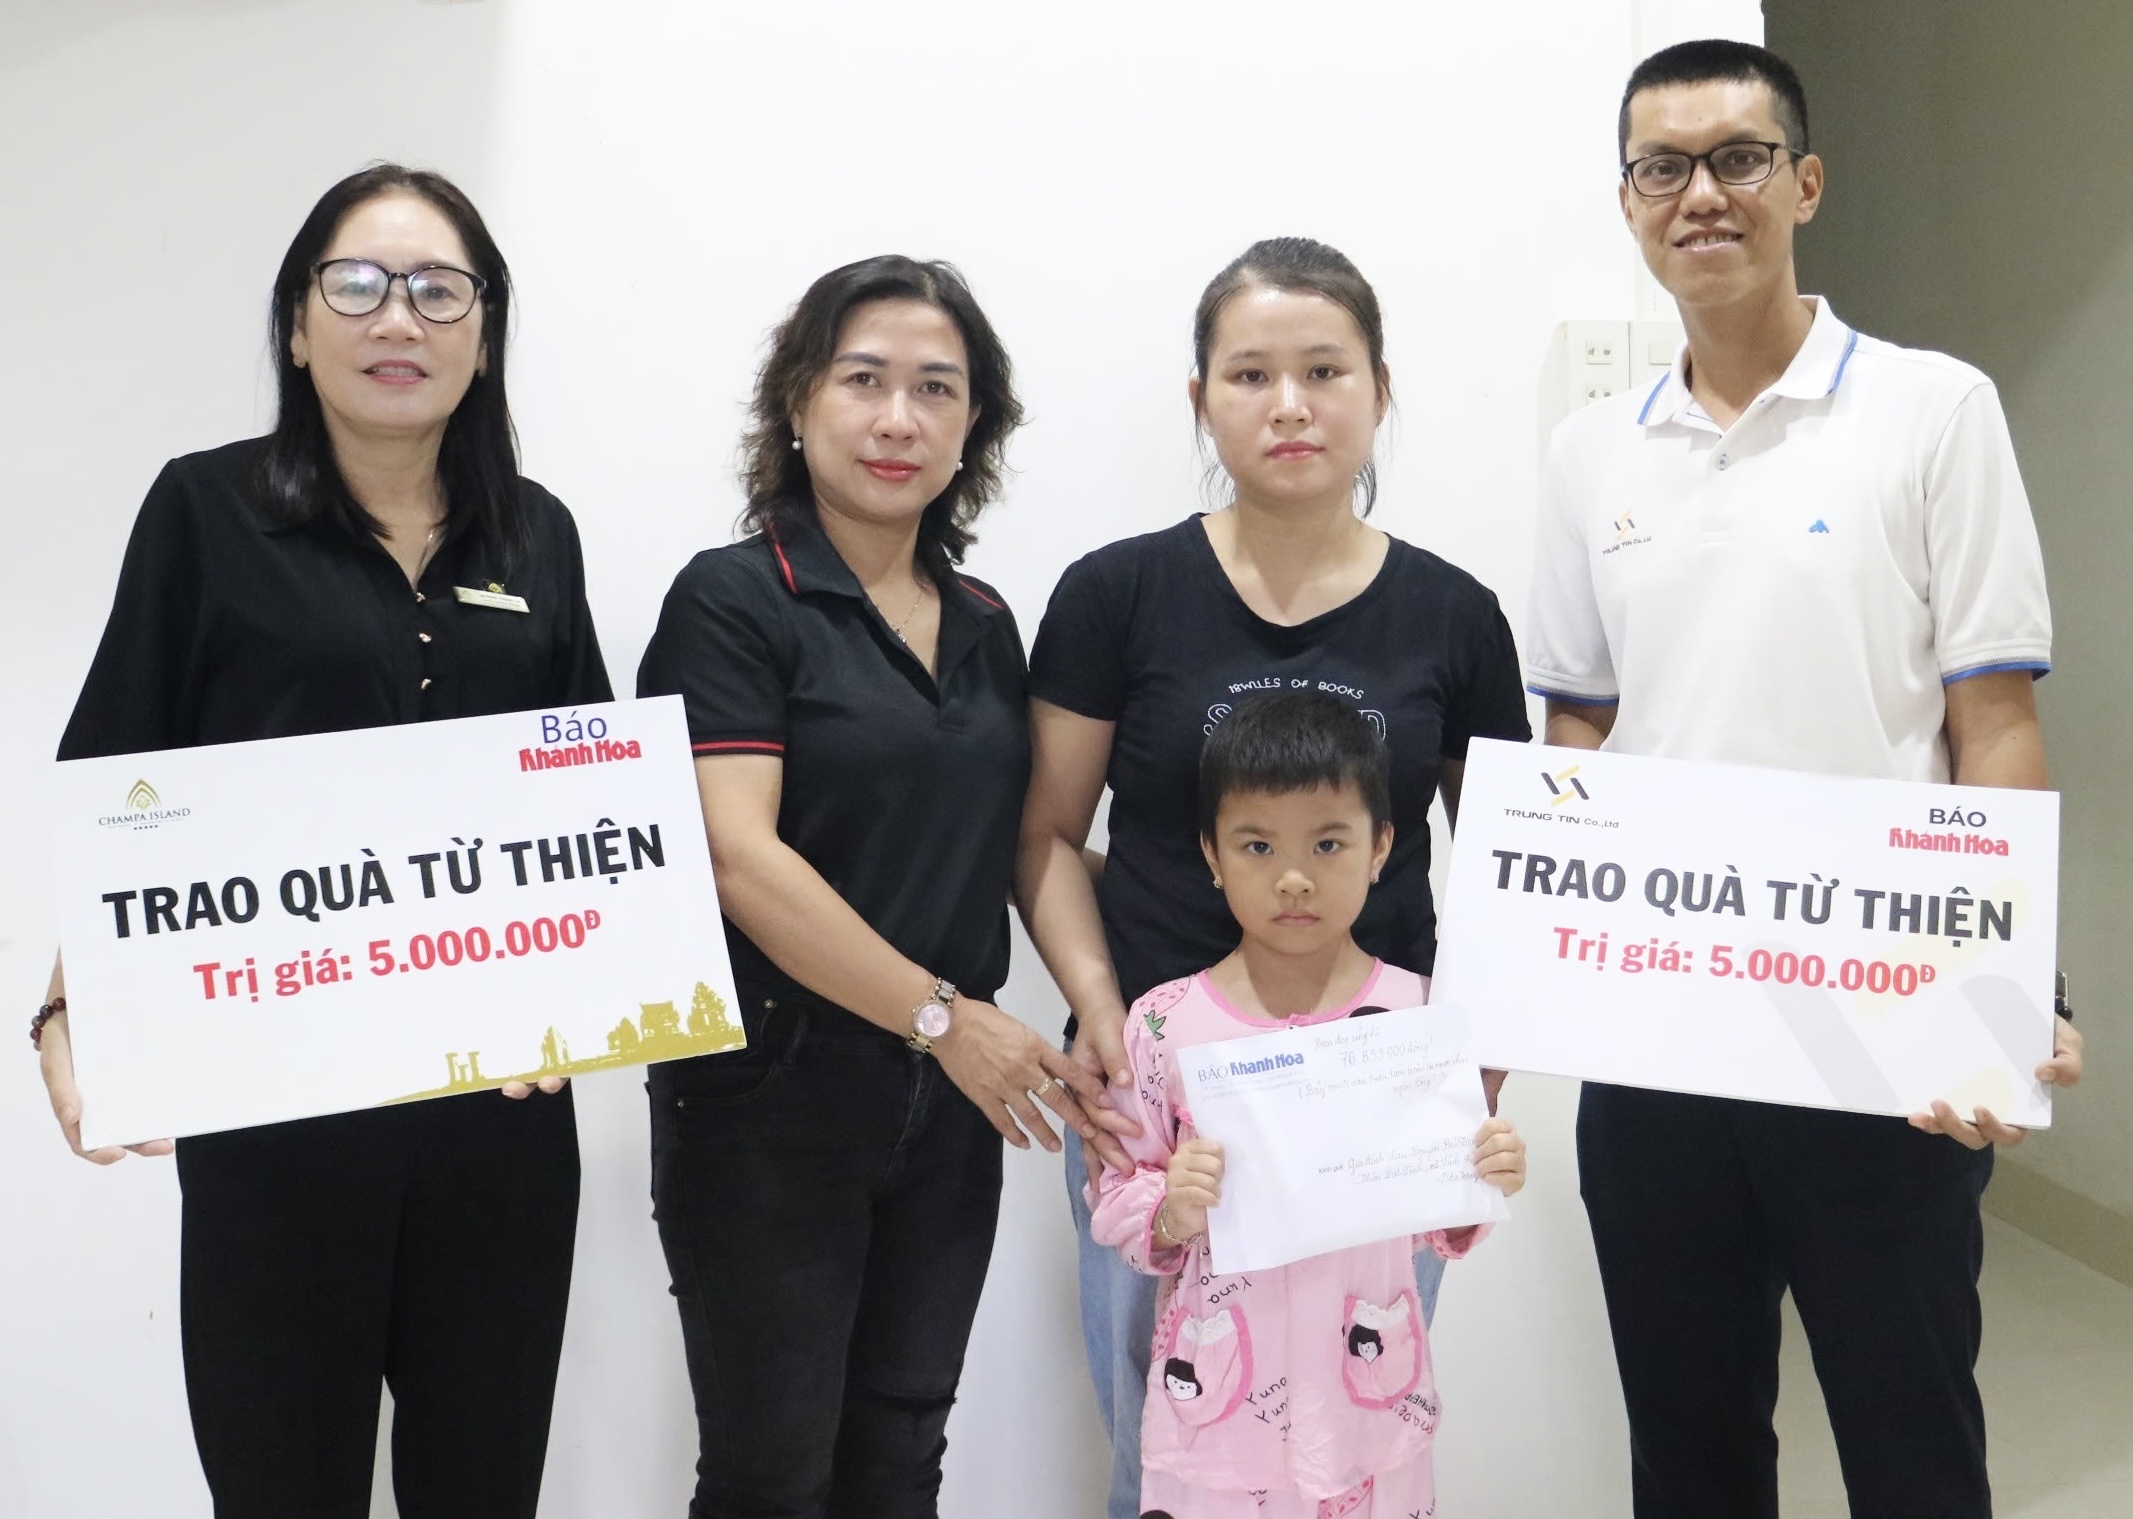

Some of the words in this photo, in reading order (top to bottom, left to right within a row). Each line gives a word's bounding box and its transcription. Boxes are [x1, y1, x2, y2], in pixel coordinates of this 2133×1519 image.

[1290, 678, 1309, 689] OF
[1317, 681, 1365, 700] BOOKS
[541, 710, 608, 744] Báo
[98, 813, 147, 826] CHAMPA
[149, 808, 191, 820] ISLAND
[1504, 808, 1552, 821] TRUNG
[1559, 815, 1579, 824] TIN
[1929, 806, 1987, 828] BÁO
[102, 876, 260, 938] TRAO
[280, 848, 394, 922] QUÀ
[408, 836, 484, 899] TỪ
[500, 817, 666, 886] THIỆN
[1492, 850, 1626, 903] TRAO
[1645, 864, 1745, 917] QUÀ
[1767, 873, 1840, 925] TỪ
[1855, 886, 2012, 947] THIỆN
[1553, 927, 1607, 971] Trị
[1621, 938, 1693, 974] giá:
[193, 958, 258, 1003] Trị
[275, 947, 353, 997] giá:
[1197, 1063, 1229, 1083] BÁO
